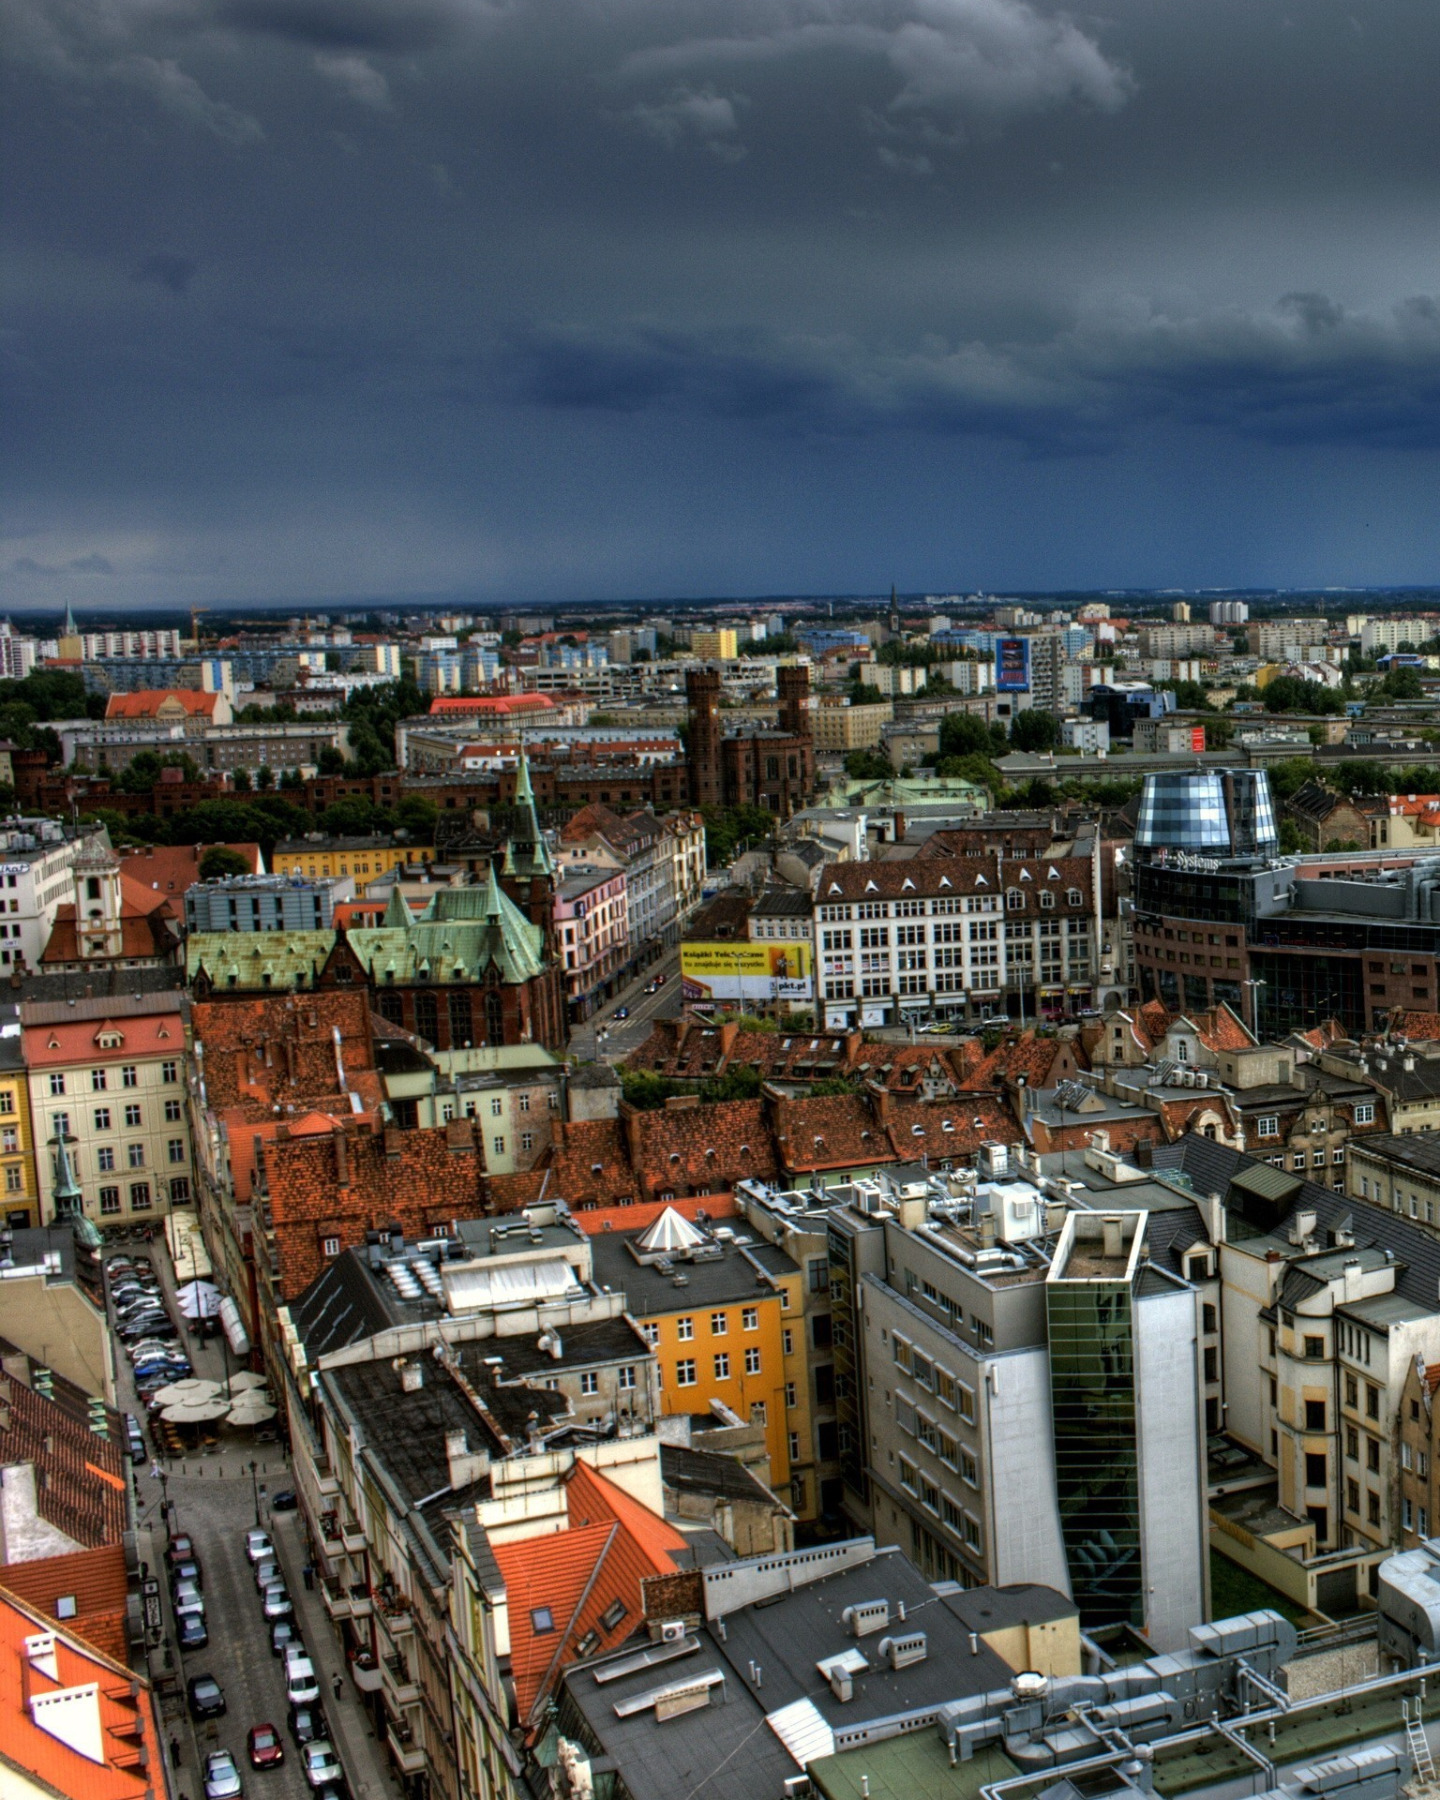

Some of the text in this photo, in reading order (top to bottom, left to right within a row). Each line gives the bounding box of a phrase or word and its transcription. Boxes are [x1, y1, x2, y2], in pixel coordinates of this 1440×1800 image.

[1176, 850, 1219, 870] Systems
[683, 951, 712, 959] Książki
[778, 981, 806, 990] pkt.pl
